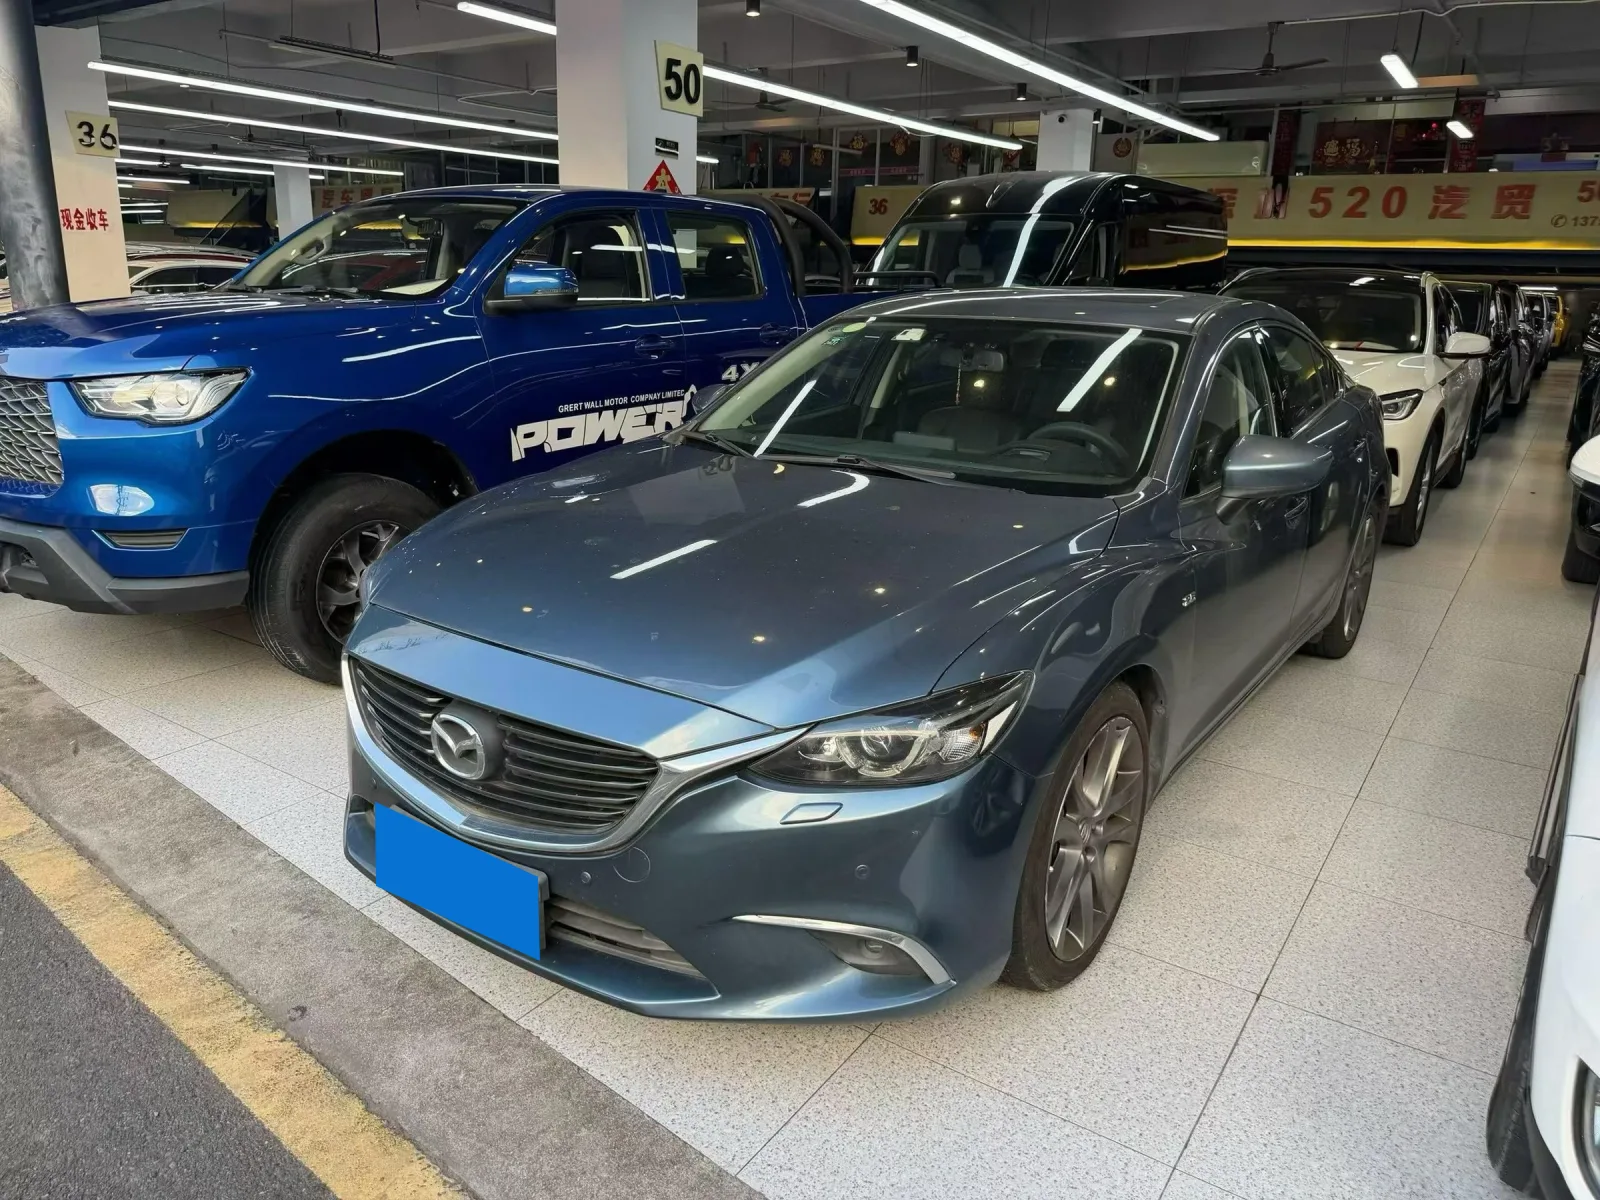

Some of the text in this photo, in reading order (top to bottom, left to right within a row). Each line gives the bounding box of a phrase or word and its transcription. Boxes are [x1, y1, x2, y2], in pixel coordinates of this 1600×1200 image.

[664, 57, 701, 105] 50
[77, 120, 118, 151] 36
[868, 197, 889, 216] 36
[59, 207, 110, 232] 现金收车
[558, 402, 584, 414] GRERT
[583, 399, 604, 410] WALL
[603, 396, 629, 407] MOTOR
[630, 391, 662, 403] COMPNAY
